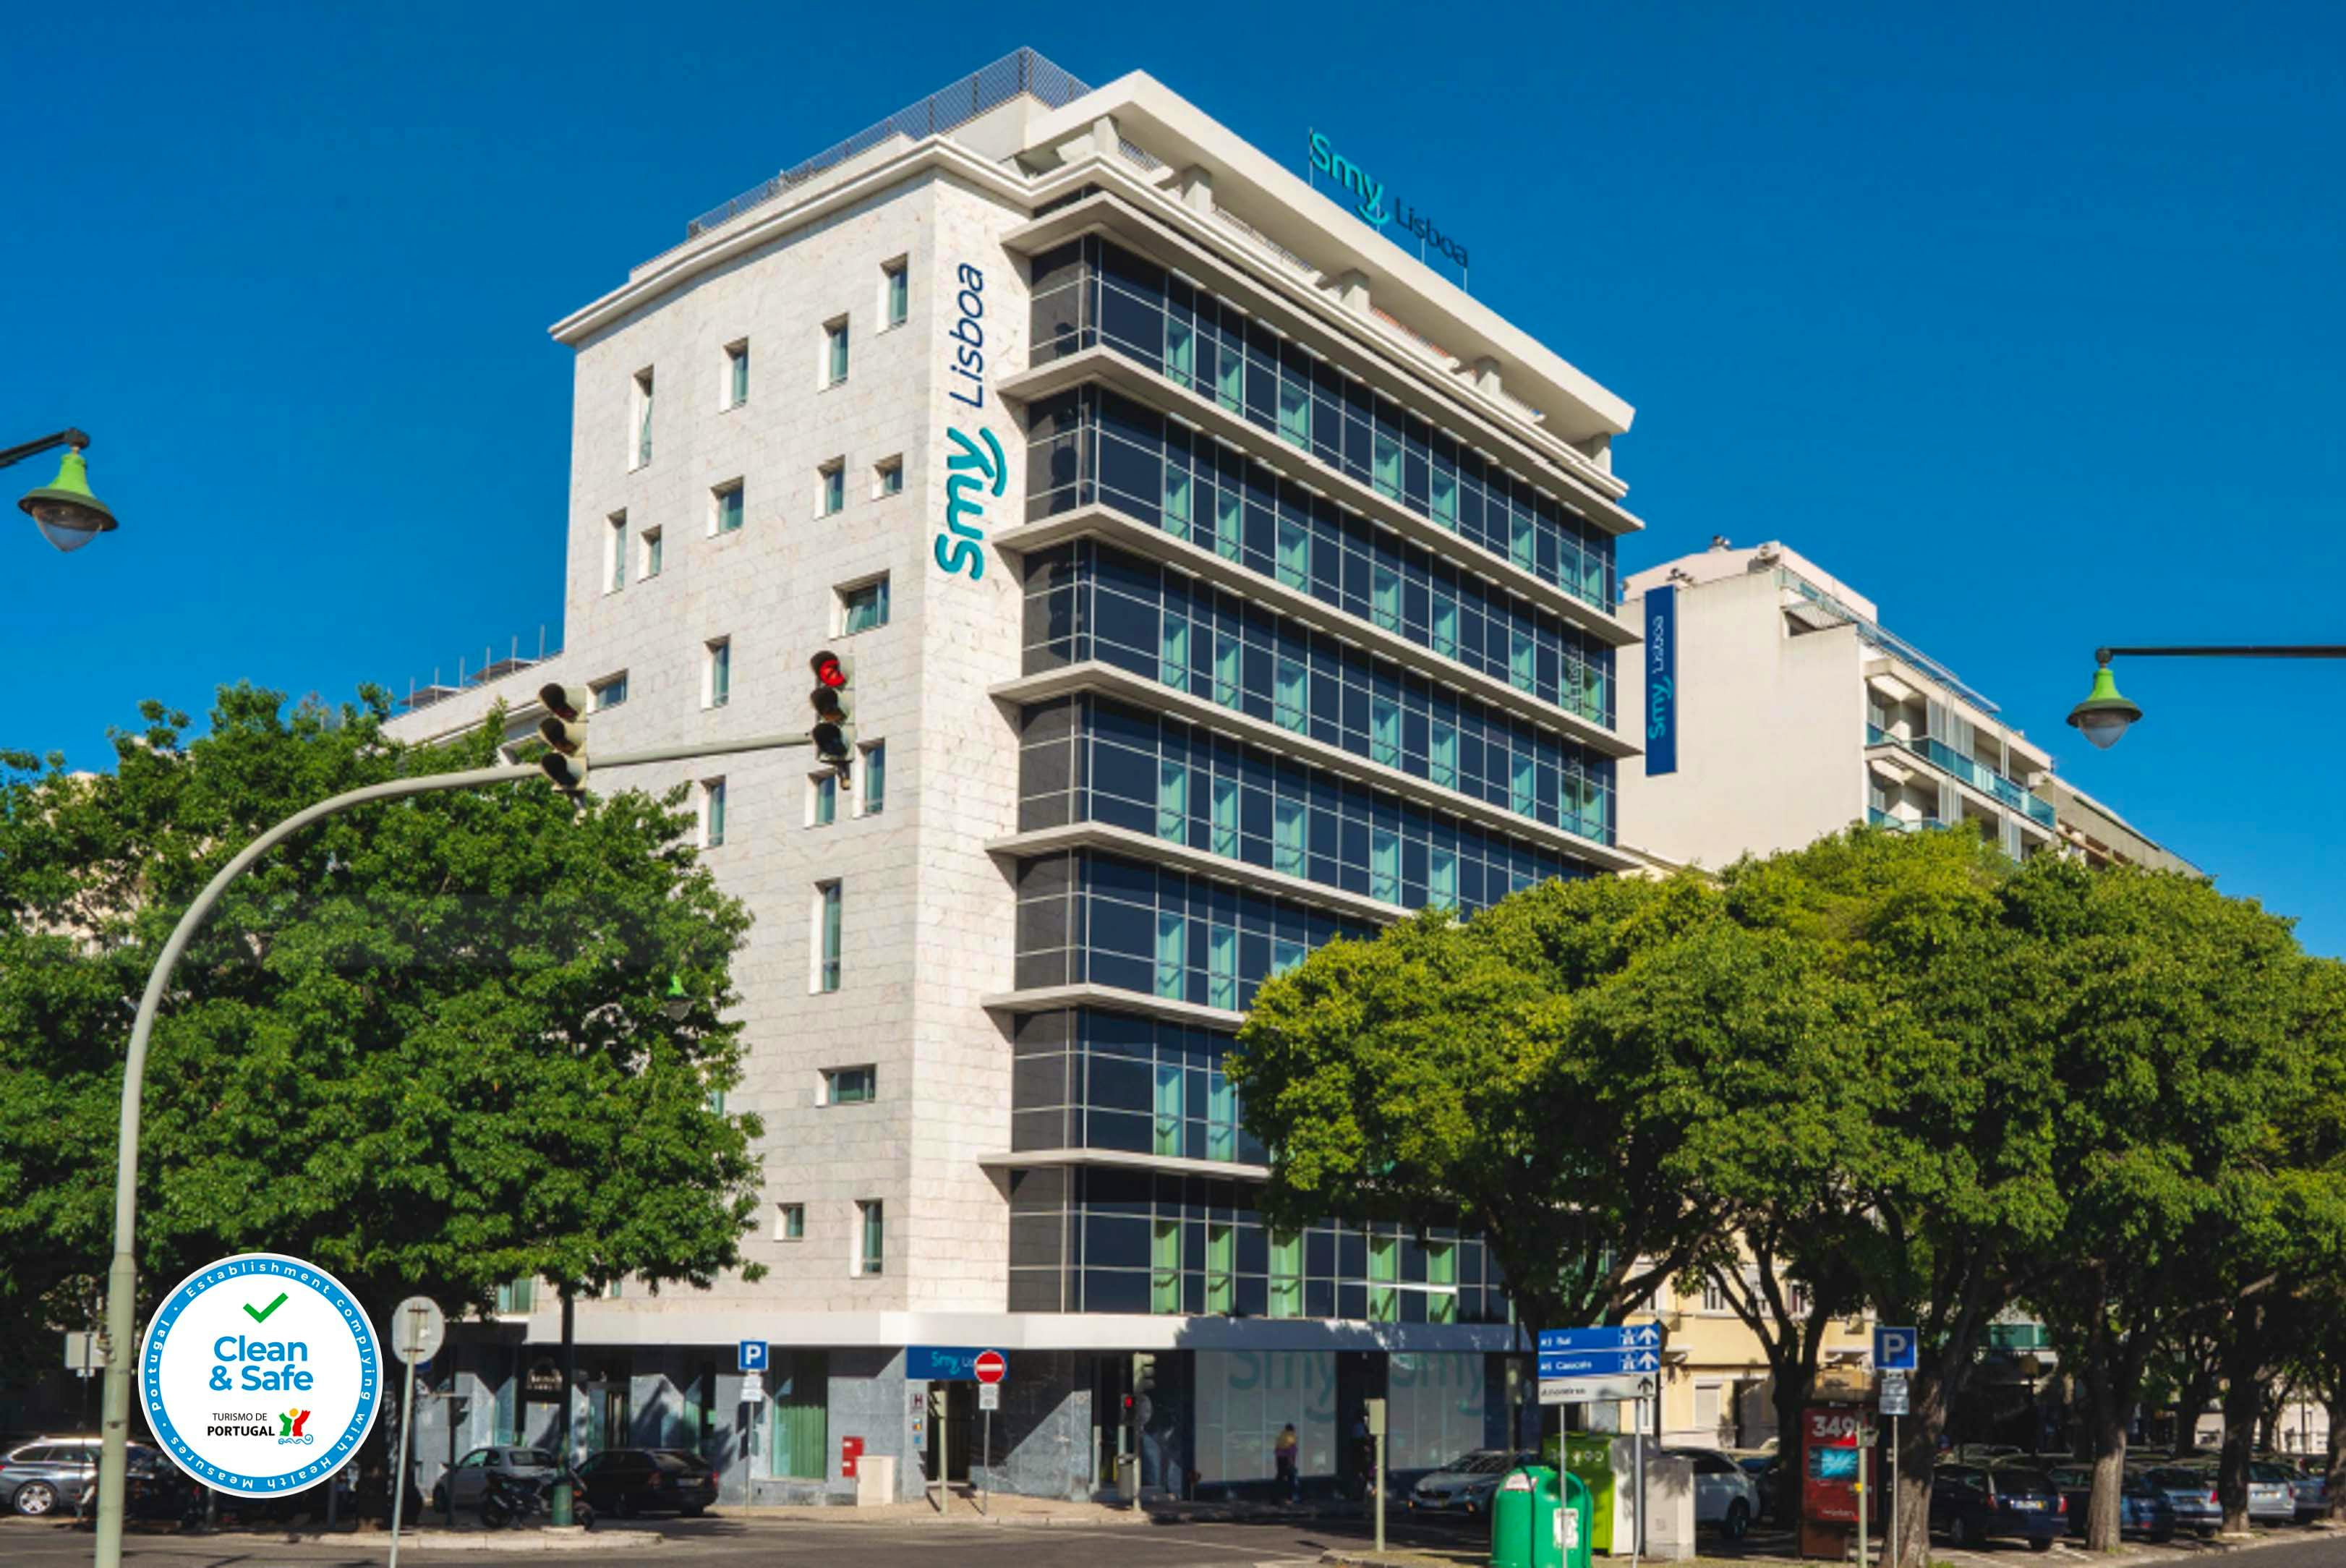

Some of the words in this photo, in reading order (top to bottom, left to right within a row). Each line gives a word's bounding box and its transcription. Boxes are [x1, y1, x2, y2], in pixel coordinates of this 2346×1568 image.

[1310, 132, 1390, 225] Smy
[1394, 196, 1468, 268] Lisboa
[949, 262, 984, 409] Lisboa
[934, 427, 1007, 581] Smy
[1648, 675, 1673, 740] Smy
[746, 1345, 762, 1365] P
[931, 1350, 961, 1375] Smy
[1883, 1333, 1906, 1363] P
